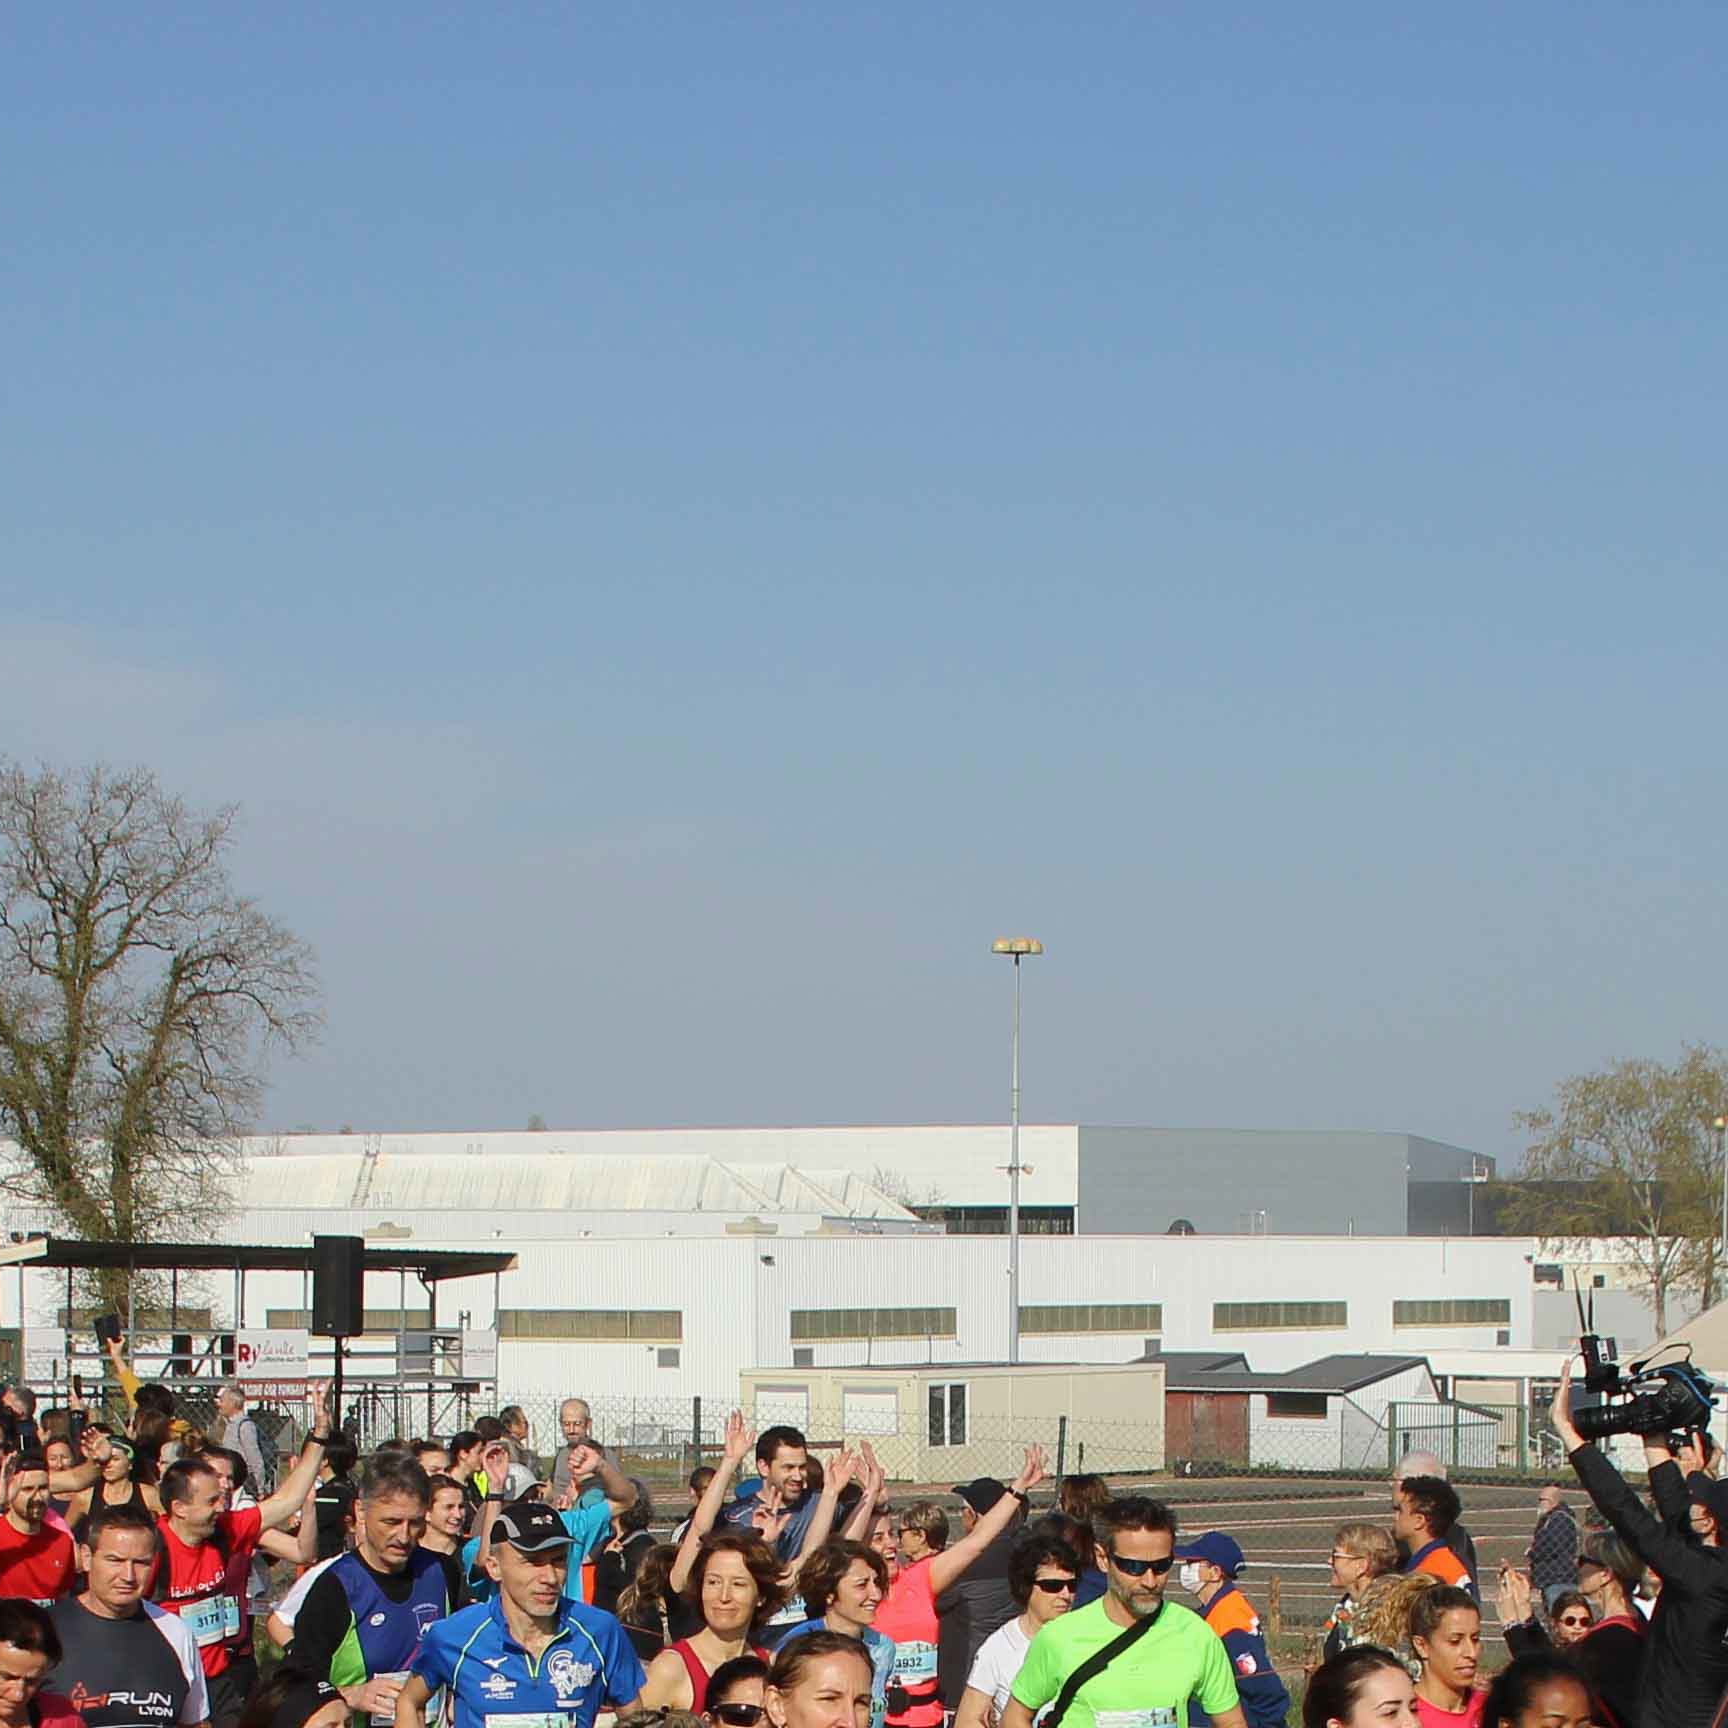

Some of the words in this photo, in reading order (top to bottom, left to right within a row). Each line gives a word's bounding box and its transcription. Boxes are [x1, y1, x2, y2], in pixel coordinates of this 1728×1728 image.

[238, 1343, 261, 1370] Ry
[895, 1656, 923, 1669] 3932
[138, 1705, 173, 1717] LYON
